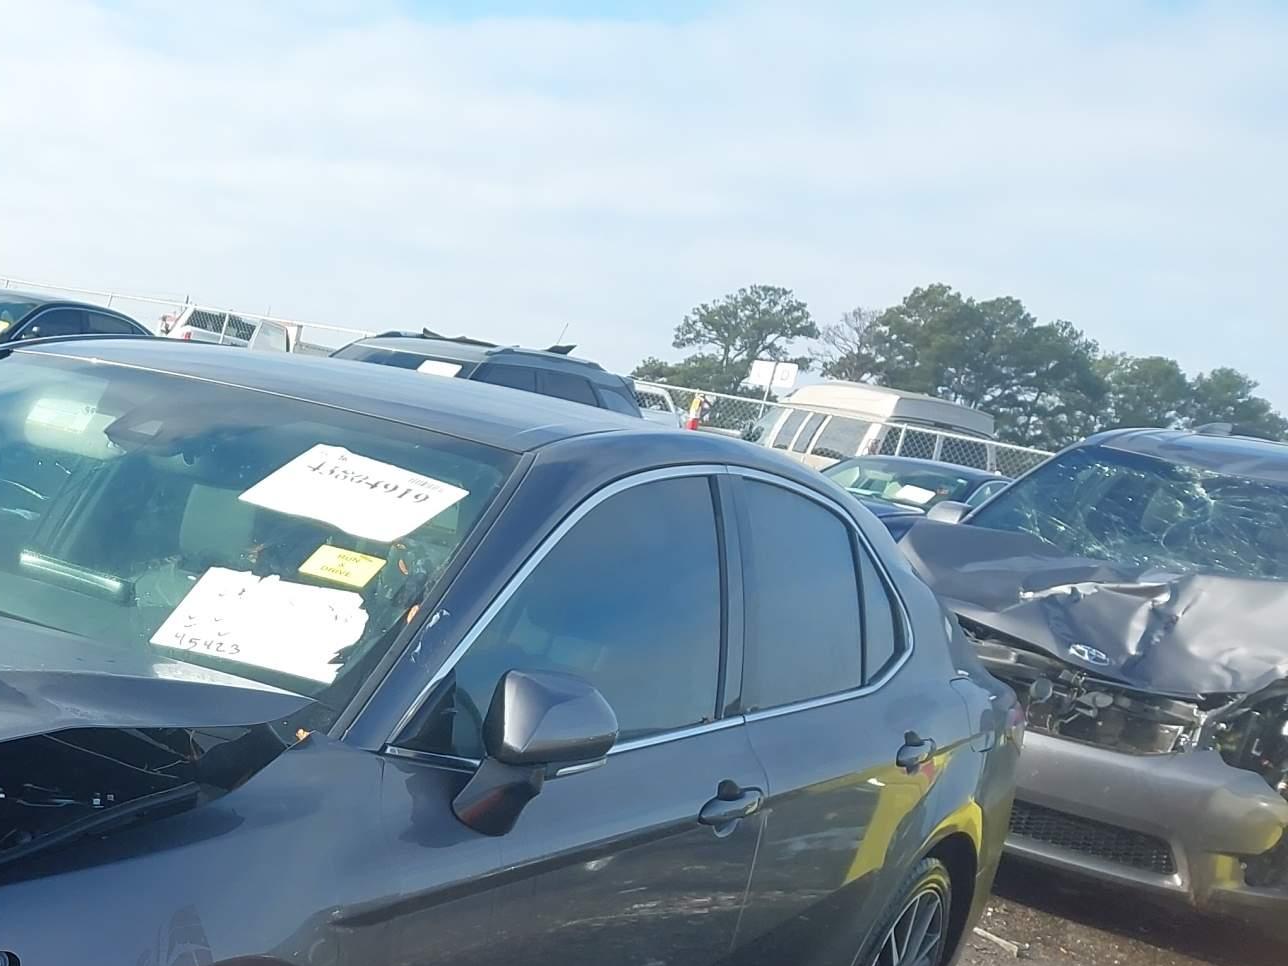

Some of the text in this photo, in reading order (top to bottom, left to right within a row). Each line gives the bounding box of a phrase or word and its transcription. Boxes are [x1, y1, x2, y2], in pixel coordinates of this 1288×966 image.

[337, 553, 362, 564] RUN
[319, 564, 353, 578] DRIVE
[174, 631, 242, 655] 45423
